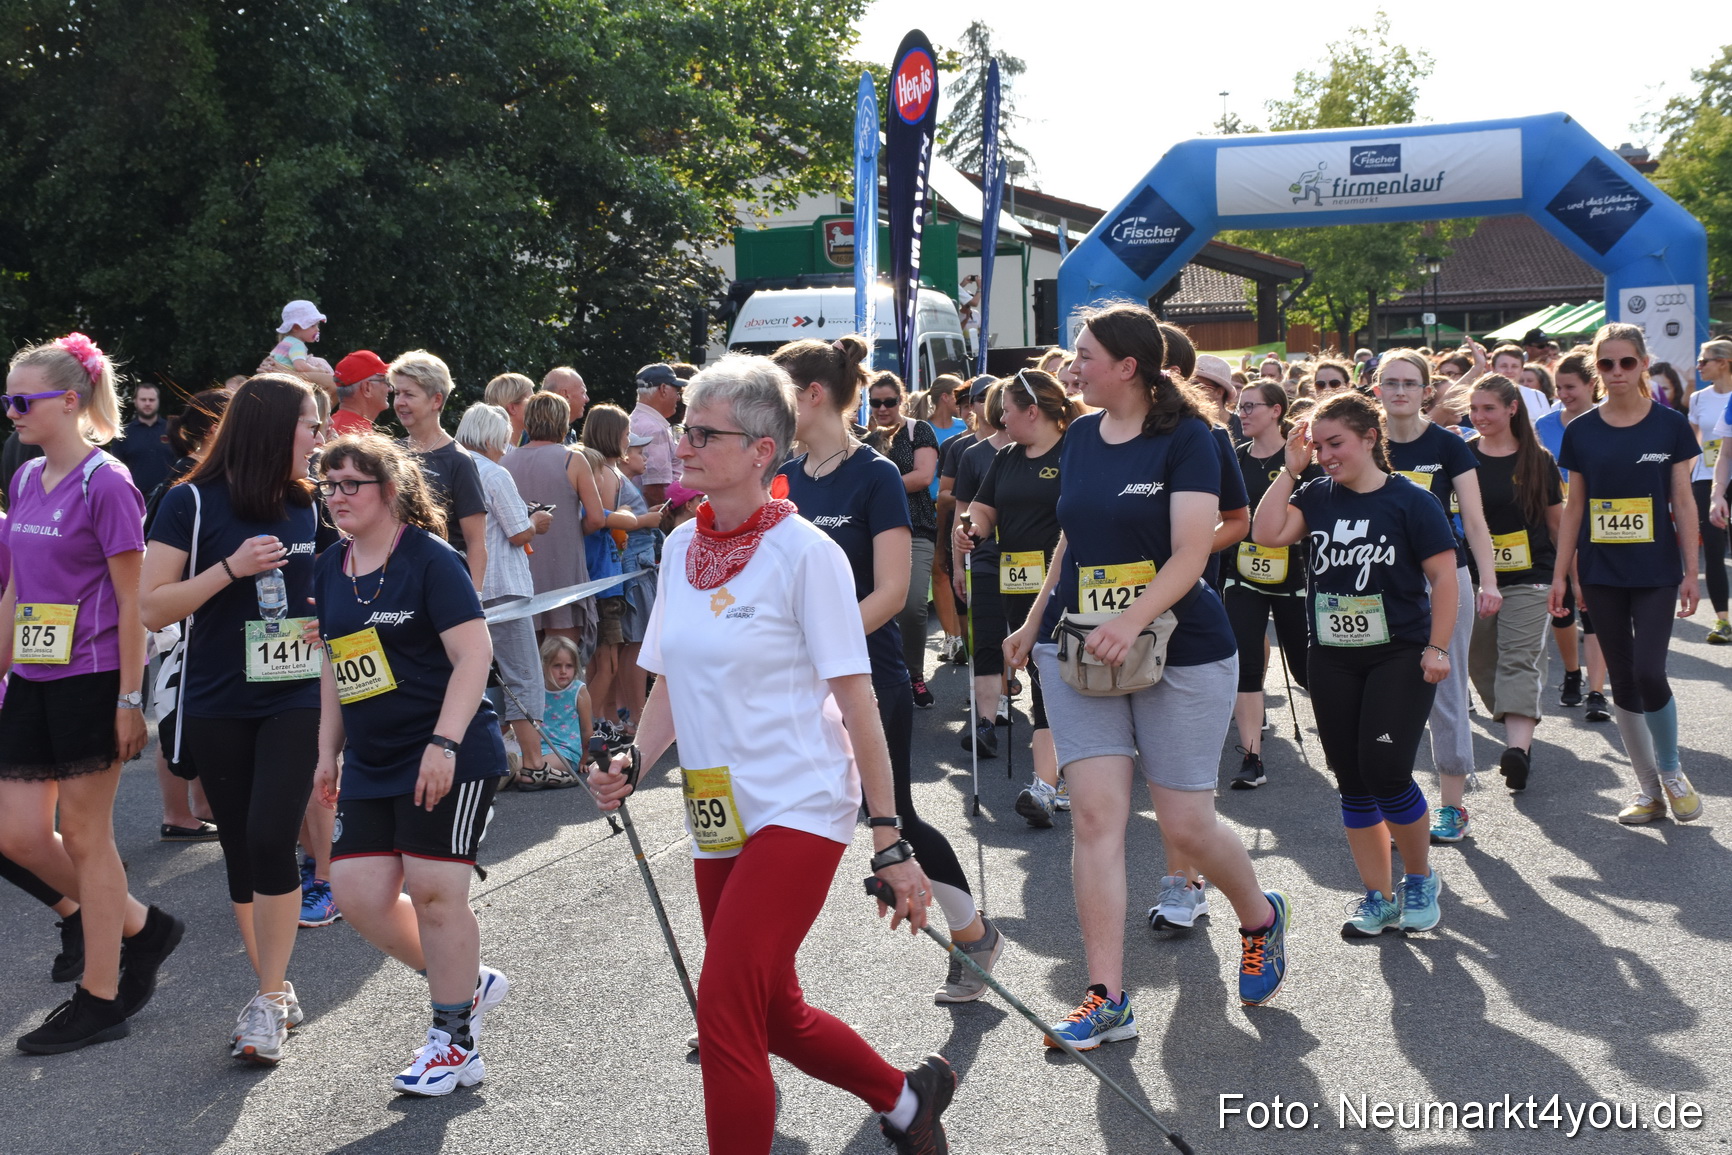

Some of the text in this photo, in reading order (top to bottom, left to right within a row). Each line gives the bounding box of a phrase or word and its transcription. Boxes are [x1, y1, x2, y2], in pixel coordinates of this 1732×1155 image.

[898, 65, 932, 107] Hervis
[1361, 155, 1398, 164] Fischer
[1332, 171, 1445, 197] firmenlauf
[1332, 197, 1378, 205] neumarkt
[1122, 226, 1180, 238] Fischer
[744, 316, 789, 328] abavent
[1636, 453, 1662, 464] JURA
[1118, 484, 1151, 496] JURA
[812, 515, 836, 526] JURA
[1598, 514, 1644, 530] 1446
[22, 524, 40, 534] SIND
[40, 526, 62, 537] LILA.
[286, 542, 311, 556] JURA
[1252, 558, 1270, 572] 55
[1310, 530, 1395, 591] Burgis
[1009, 567, 1028, 582] 64
[1088, 585, 1146, 611] 1425
[364, 612, 399, 624] JURA
[1330, 614, 1368, 633] 389
[22, 626, 56, 646] 875
[258, 640, 312, 664] 1417
[355, 677, 381, 689] Jeanette
